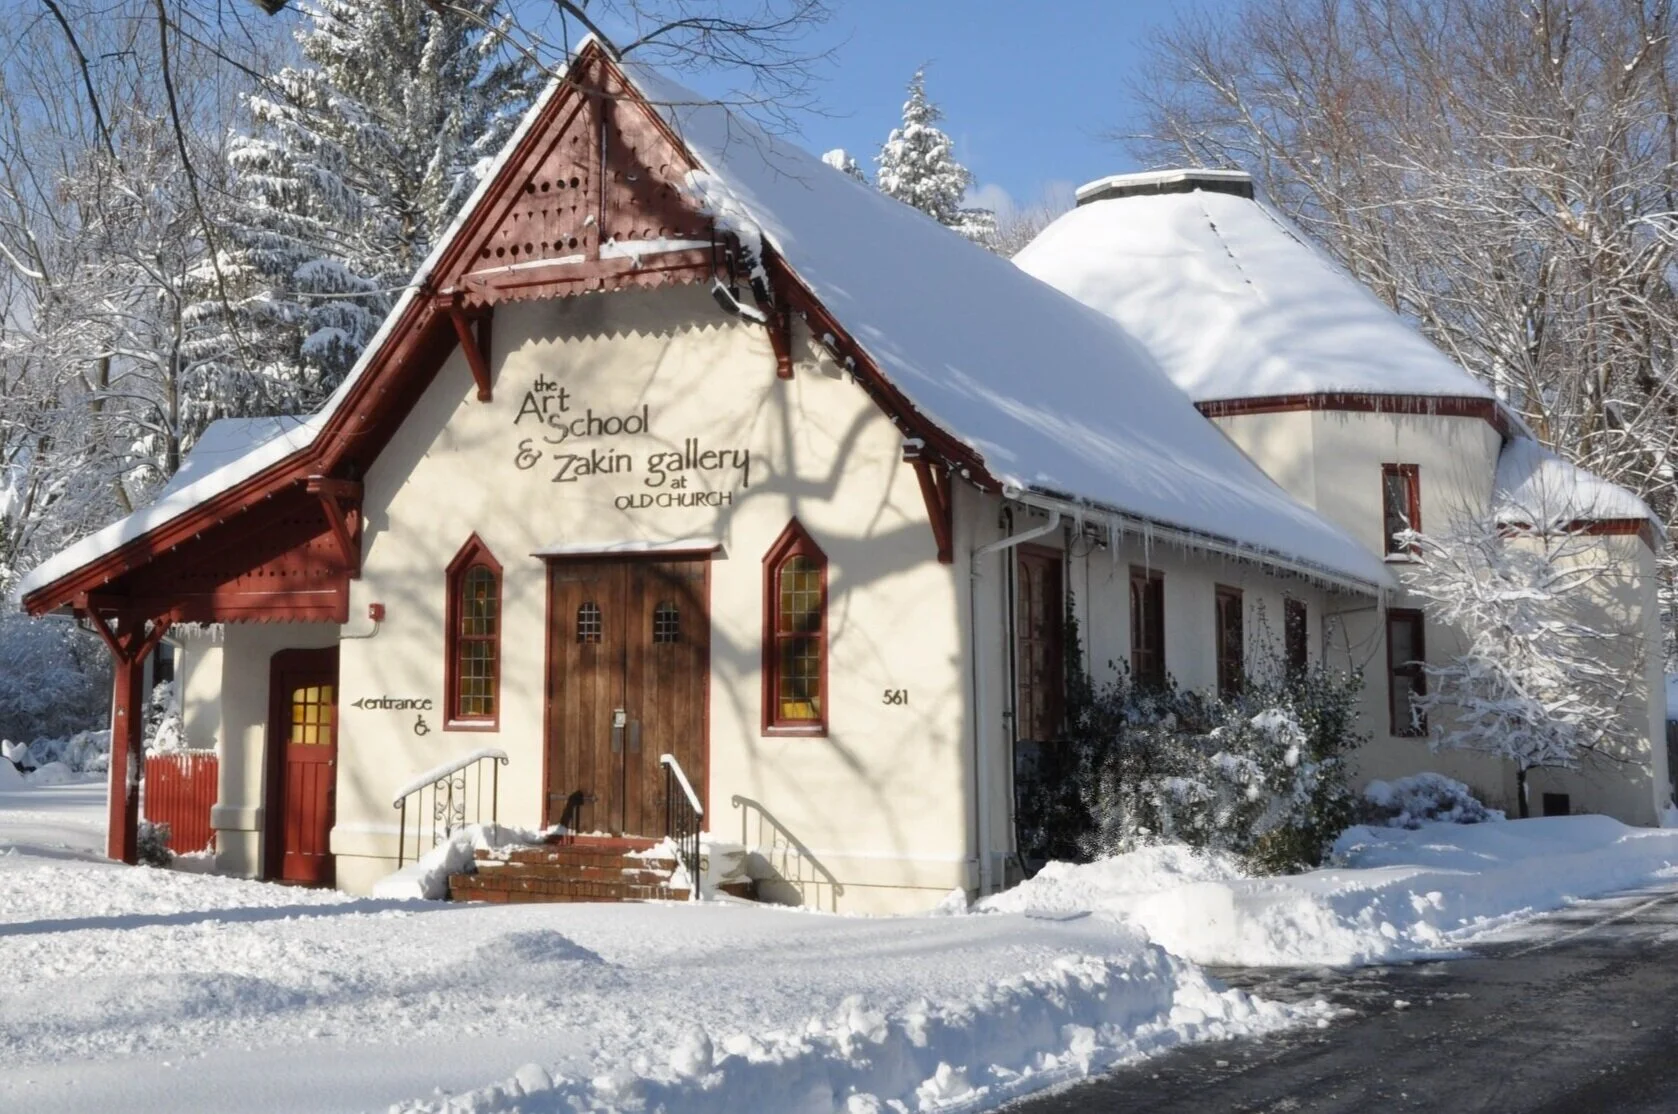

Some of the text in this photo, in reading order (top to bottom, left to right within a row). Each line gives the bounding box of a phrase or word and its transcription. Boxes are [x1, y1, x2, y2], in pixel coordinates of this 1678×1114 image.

[534, 373, 558, 392] the
[513, 386, 570, 425] Art
[543, 404, 649, 445] School
[514, 438, 542, 470] &
[644, 437, 750, 488] gallery
[670, 475, 688, 489] at
[614, 491, 732, 511] OLD CHURCH
[364, 695, 433, 711] entrance
[882, 689, 908, 705] 561
